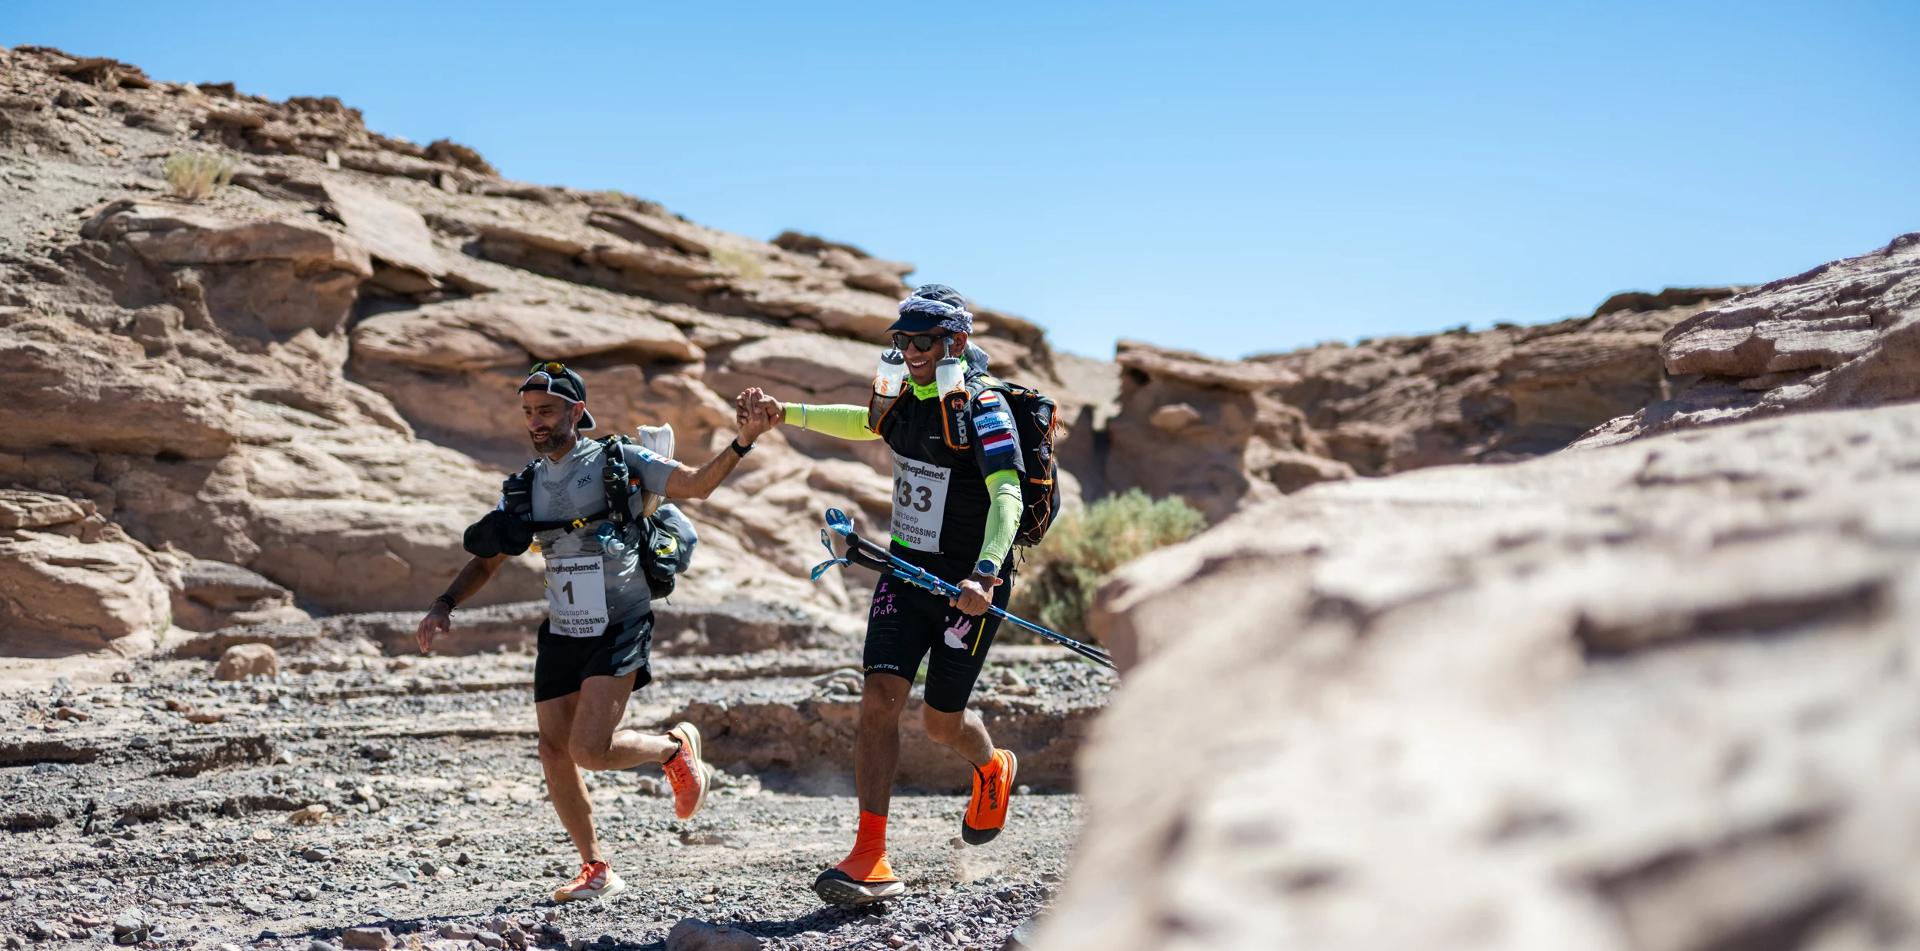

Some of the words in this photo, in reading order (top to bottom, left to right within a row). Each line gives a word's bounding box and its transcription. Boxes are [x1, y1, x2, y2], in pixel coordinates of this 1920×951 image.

[956, 411, 968, 445] MDS
[901, 523, 937, 539] CROSSING
[906, 534, 922, 545] 2025
[562, 581, 575, 605] 1
[558, 609, 590, 618] oustapha
[571, 617, 606, 626] CROSSING
[579, 626, 594, 634] 2025
